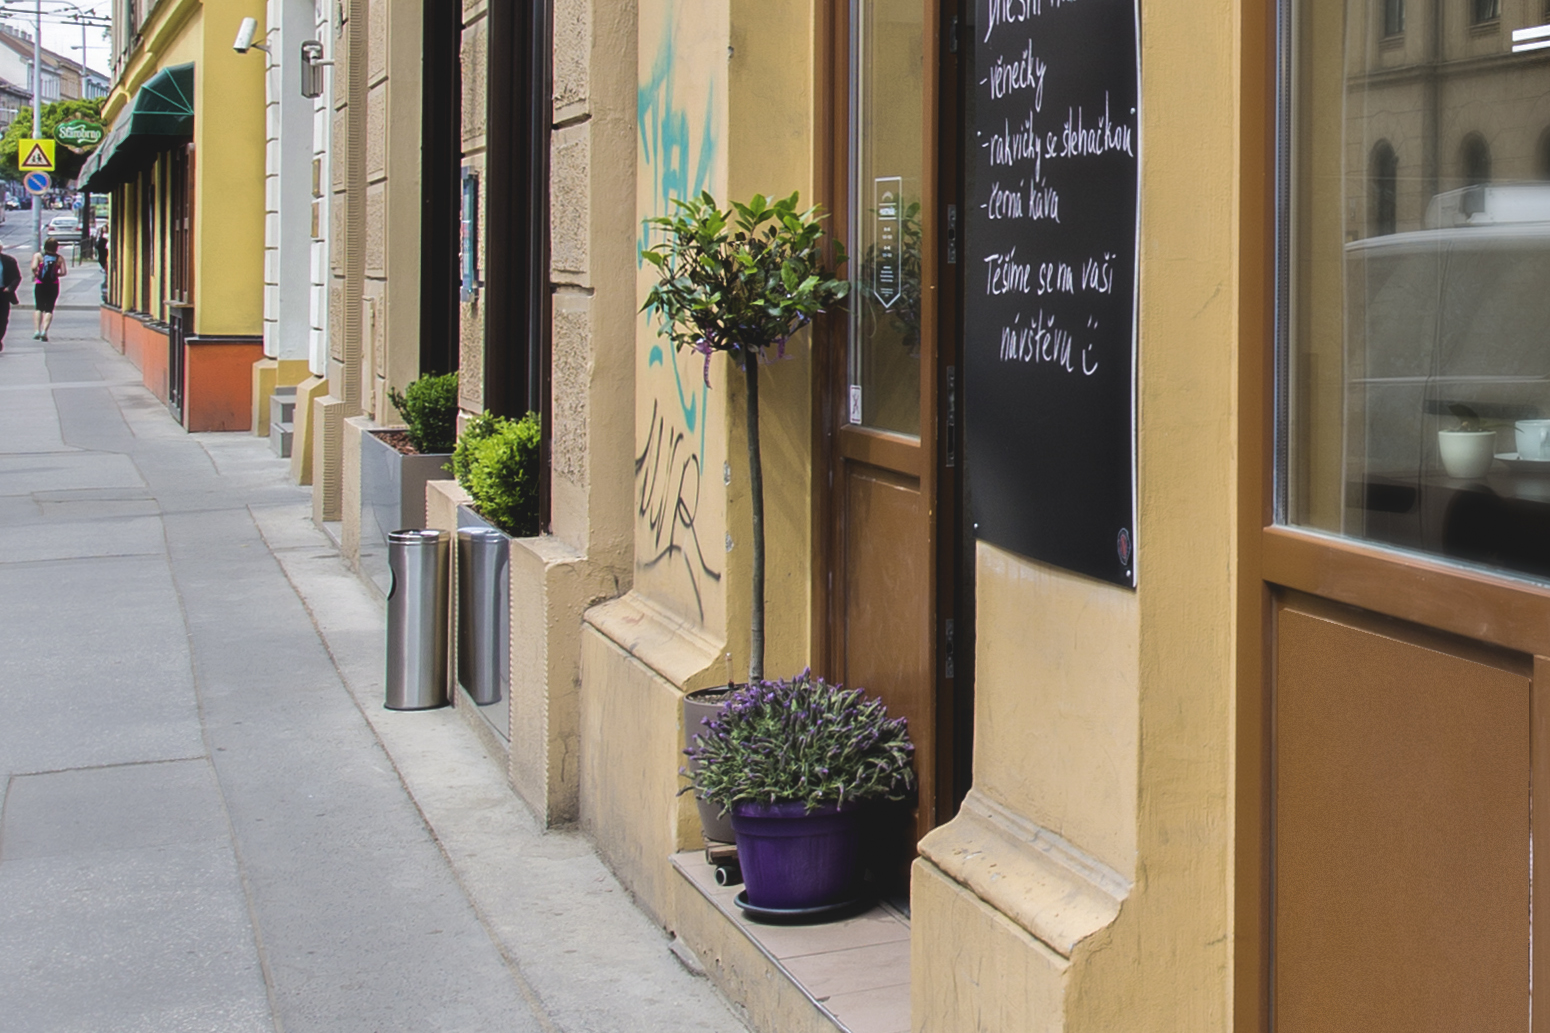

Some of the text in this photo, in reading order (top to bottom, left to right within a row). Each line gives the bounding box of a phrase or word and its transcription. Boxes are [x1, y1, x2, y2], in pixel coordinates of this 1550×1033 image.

[1045, 132, 1057, 158] se
[1029, 176, 1060, 223] káva
[1037, 262, 1054, 295] se
[1057, 261, 1074, 295] na
[1082, 252, 1116, 294] vaši
[1000, 309, 1073, 372] návštěvu
